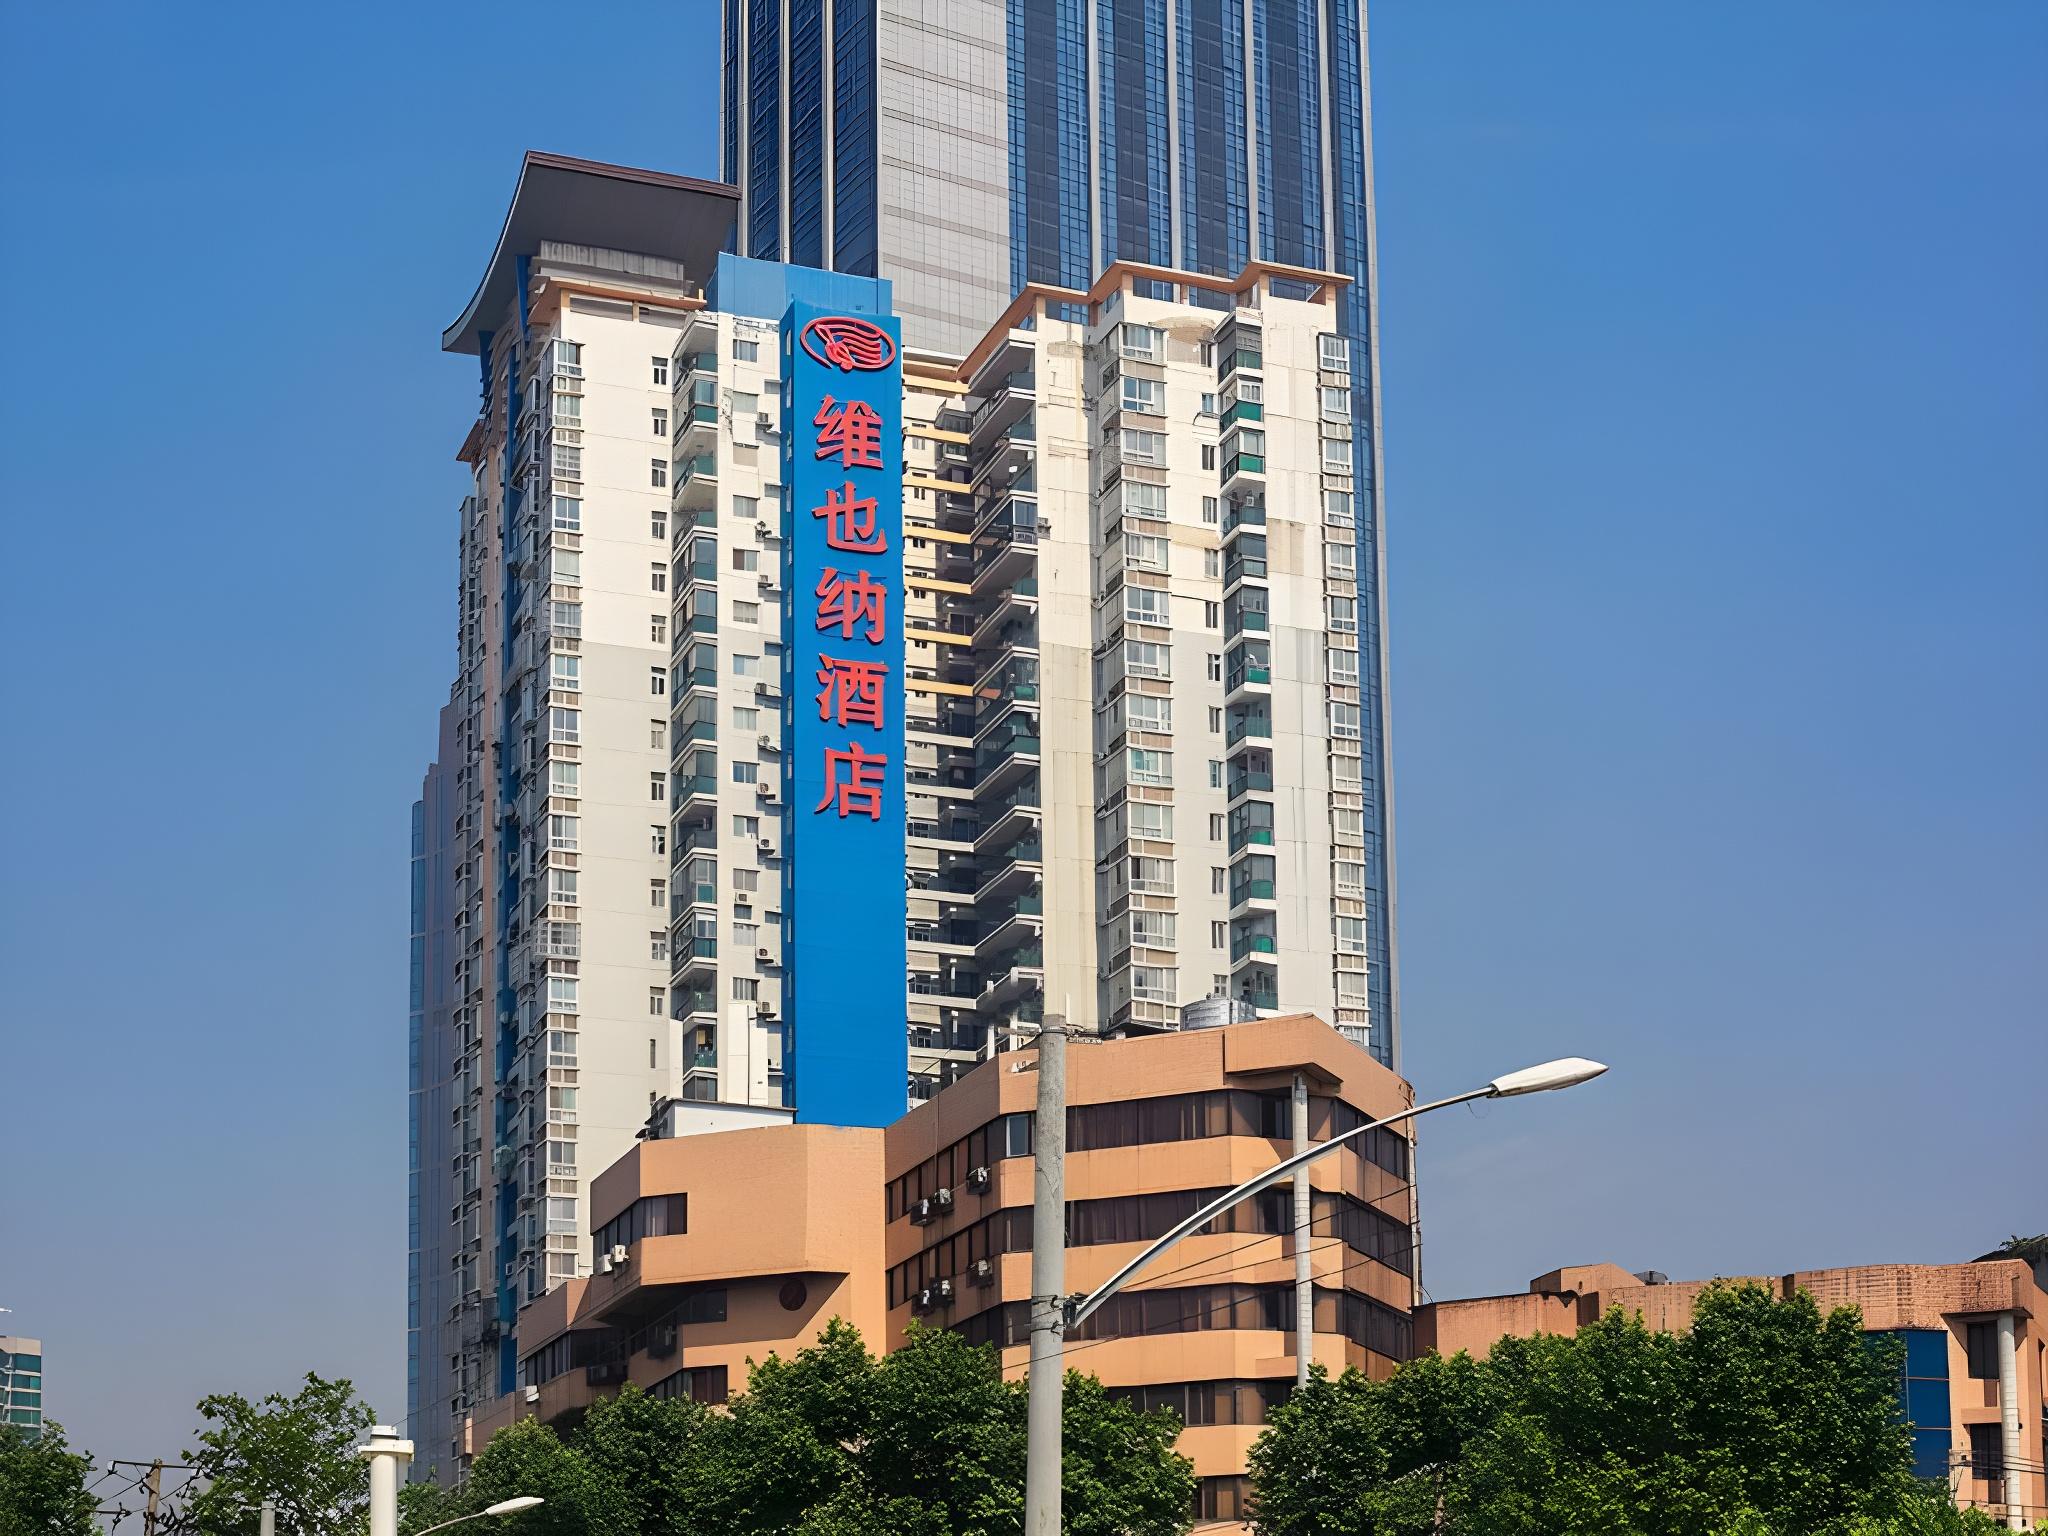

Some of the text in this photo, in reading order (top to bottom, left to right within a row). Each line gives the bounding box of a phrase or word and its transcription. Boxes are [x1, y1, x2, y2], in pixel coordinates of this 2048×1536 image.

[812, 395, 888, 821] 维也纳酒店
